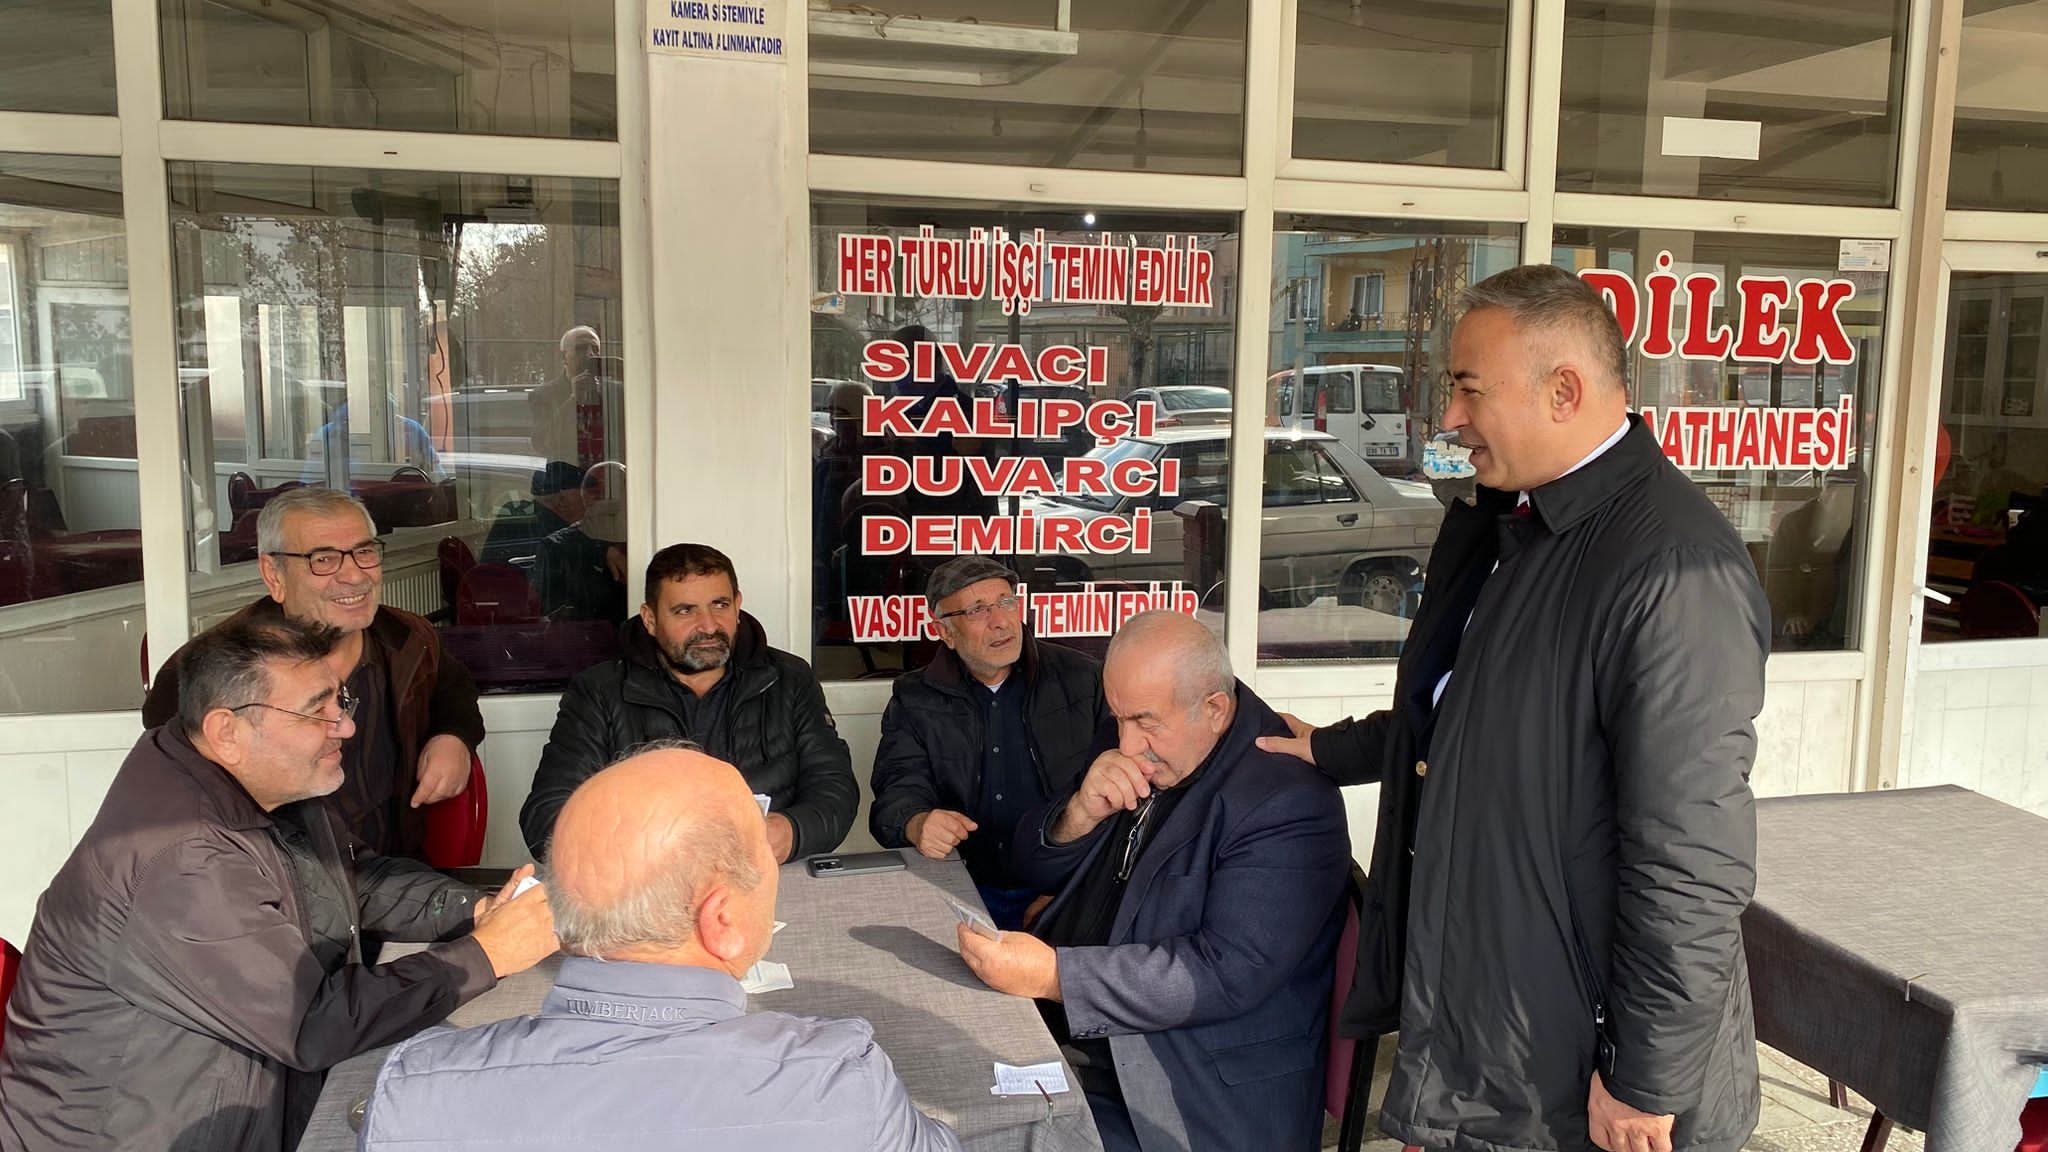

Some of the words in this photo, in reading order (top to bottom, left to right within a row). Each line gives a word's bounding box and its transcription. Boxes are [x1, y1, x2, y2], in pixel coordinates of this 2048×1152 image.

[671, 1, 709, 21] KAMERA
[653, 29, 680, 48] KAYIT
[682, 31, 714, 50] ALTINA
[837, 233, 896, 296] HER
[899, 224, 987, 300] TÜRLÜ
[992, 226, 1045, 316] İŞÇİ
[1048, 232, 1128, 305] TEMİN
[1132, 234, 1213, 308] EDİLİR
[861, 339, 1108, 386] SIVACI
[862, 395, 1157, 448] KALIPÇI
[862, 455, 1180, 496] DUVARCI
[861, 507, 1151, 556] DEMİRCİ
[1033, 583, 1114, 639] TEMİN
